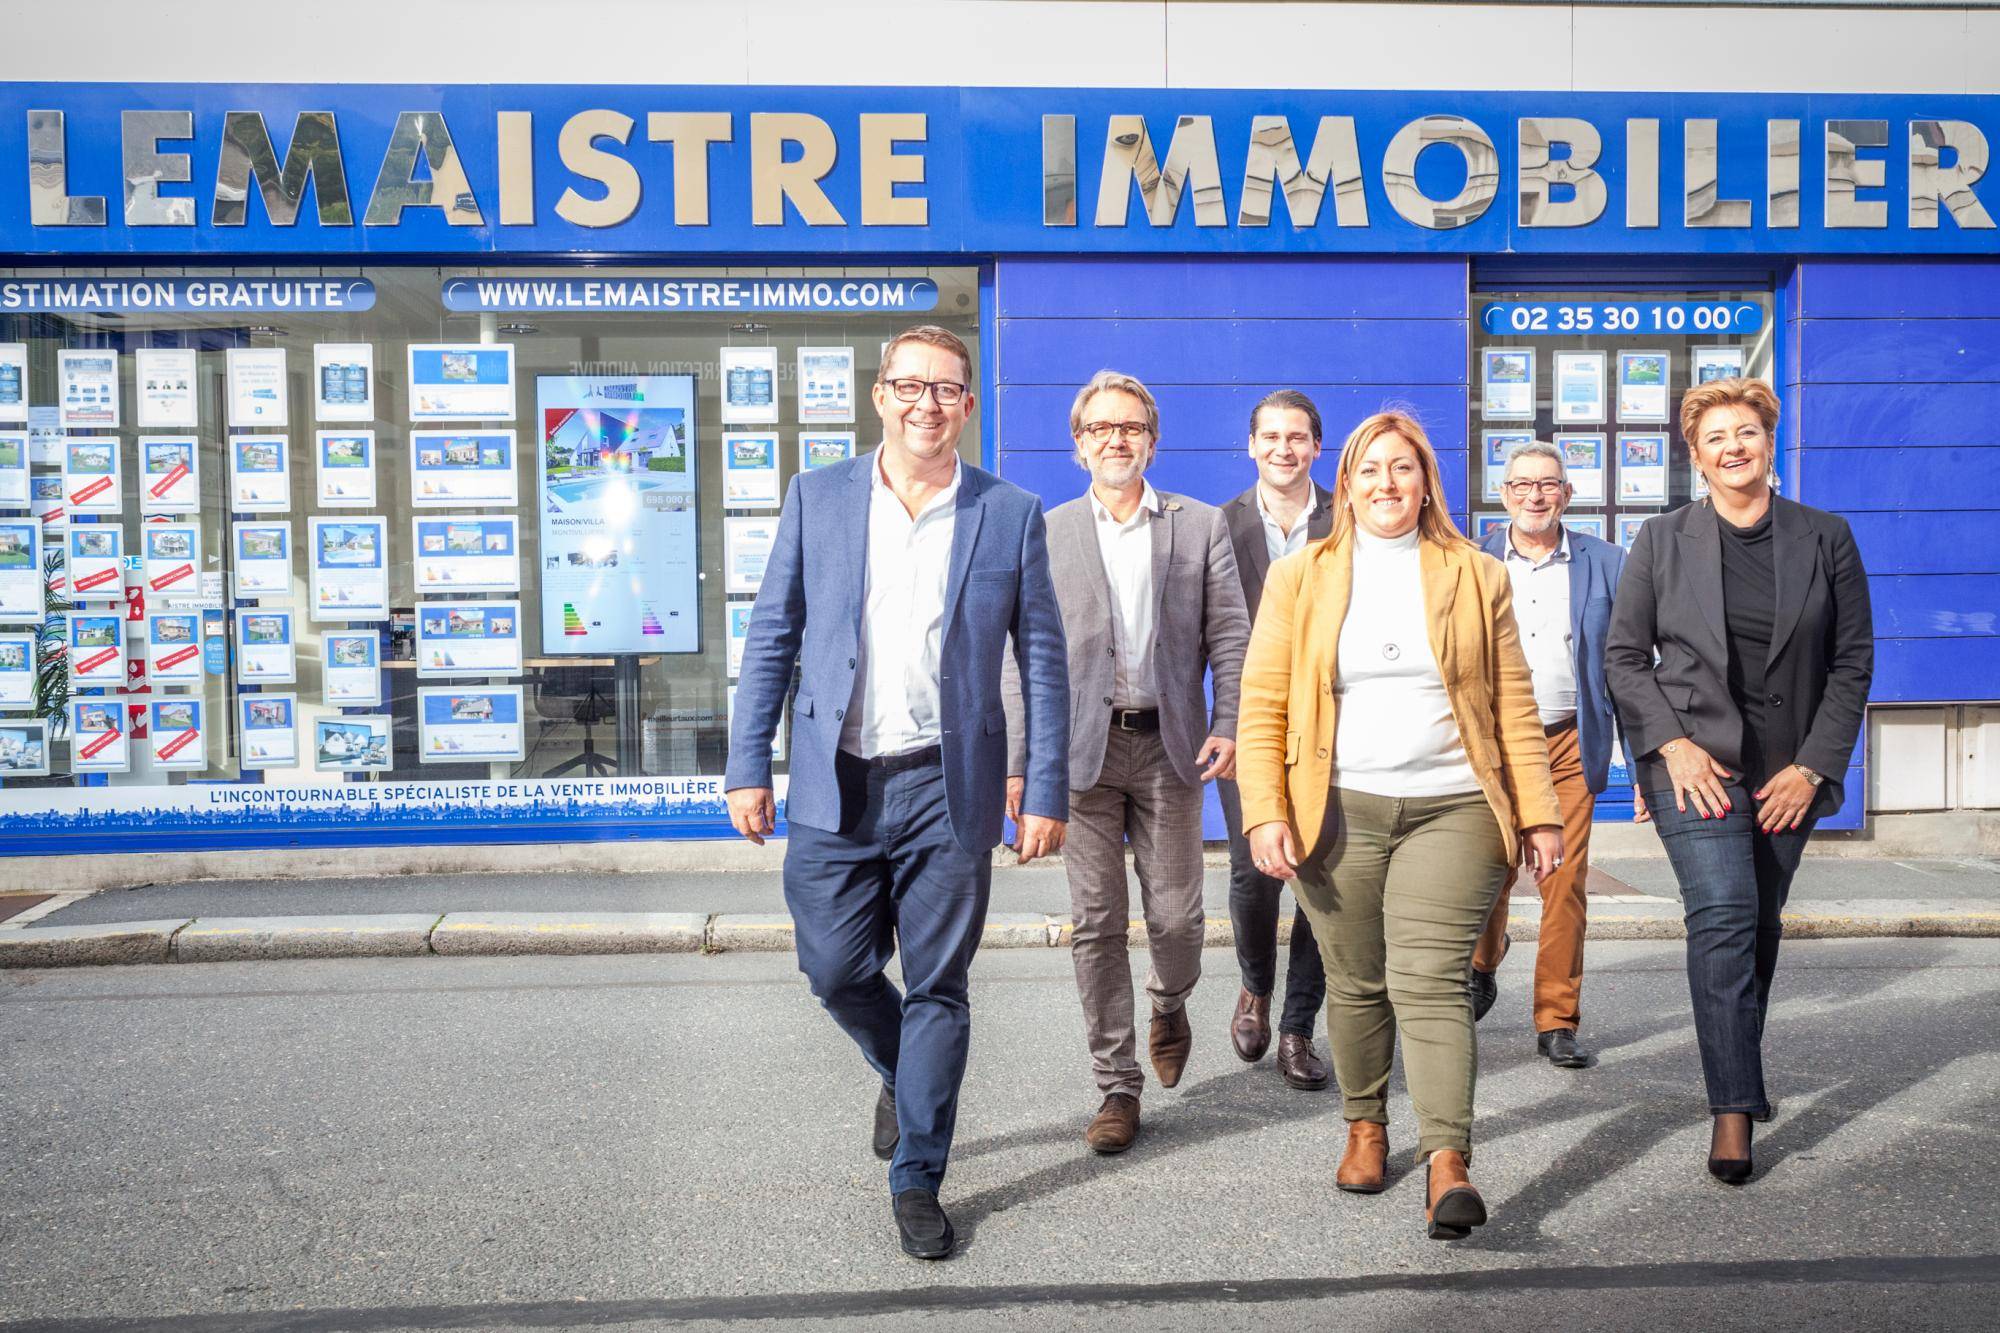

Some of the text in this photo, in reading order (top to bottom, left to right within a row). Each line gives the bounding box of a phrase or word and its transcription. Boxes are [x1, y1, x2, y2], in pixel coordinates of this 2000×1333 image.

[27, 109, 1998, 230] LEMAISTRE IMMOBILIER
[0, 283, 343, 307] STIMATION GRATUITE
[477, 283, 904, 307] WWW.LEMAISTRE-IMMO.COM
[1511, 306, 1731, 330] 02 35 30 10 00
[211, 780, 718, 803] L'INCONTOURNABLE SPÉCIALISTE DE LA VENTE IMMOBILIÈRE
